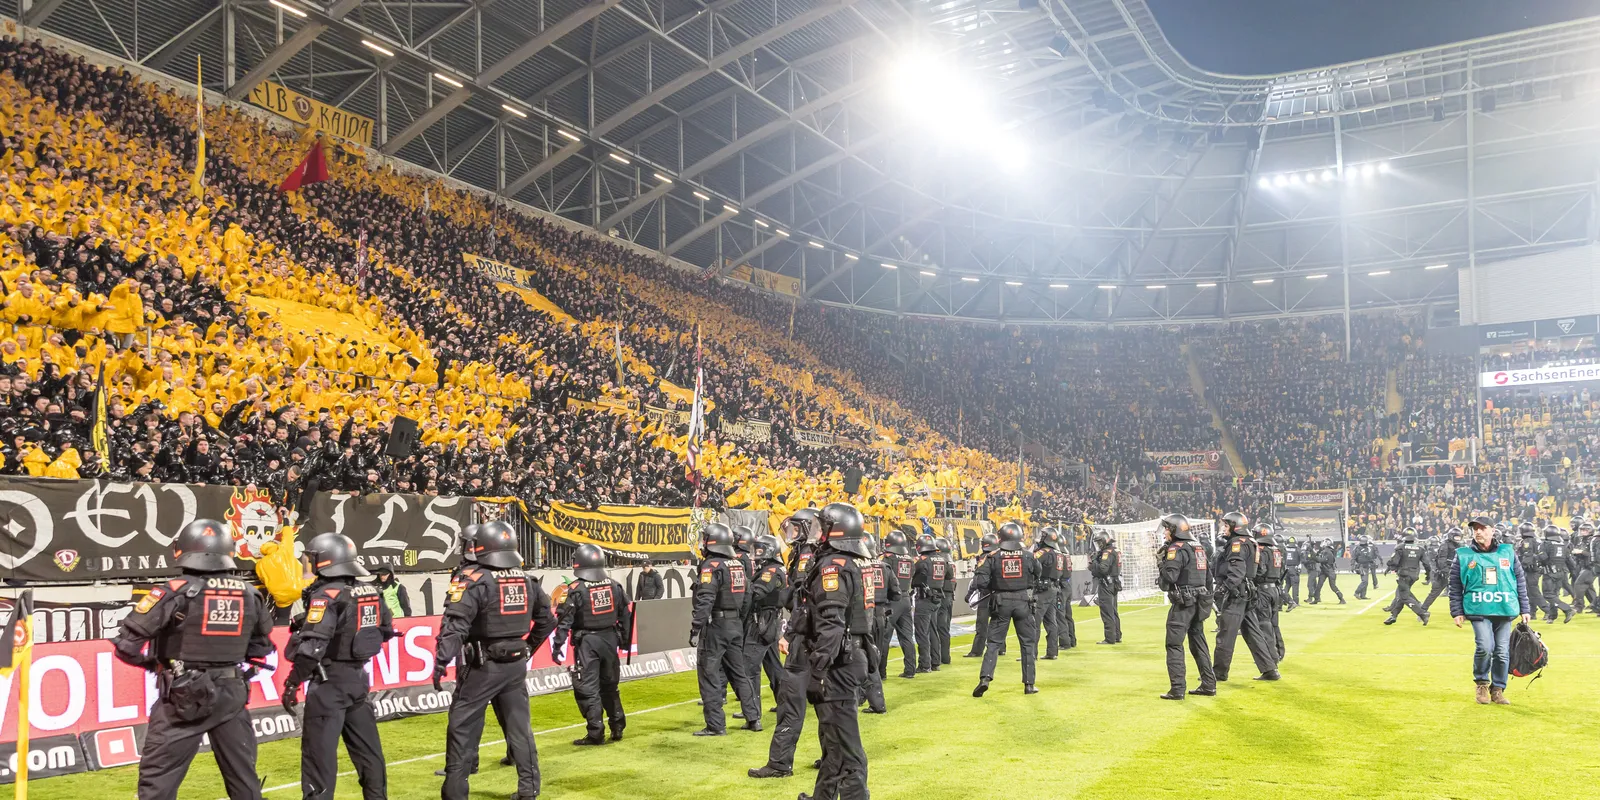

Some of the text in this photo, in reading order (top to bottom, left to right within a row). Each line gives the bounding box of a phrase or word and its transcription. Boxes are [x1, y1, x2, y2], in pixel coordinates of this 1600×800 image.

[320, 106, 370, 142] KAIDA
[476, 258, 517, 280] DRITTE
[637, 522, 689, 546] BAUTZEN
[101, 554, 168, 571] DYNA
[356, 555, 402, 566] SDEN
[491, 569, 525, 579] POLIZEI
[207, 577, 246, 590] OLIZEI
[508, 586, 519, 595] BY
[597, 591, 606, 600] BY
[505, 594, 524, 603] 6233
[594, 598, 611, 606] 6233
[1472, 591, 1511, 603] HOST
[217, 599, 233, 610] BY
[210, 610, 239, 621] 6233
[364, 606, 374, 615] BY
[362, 615, 377, 625] 6233
